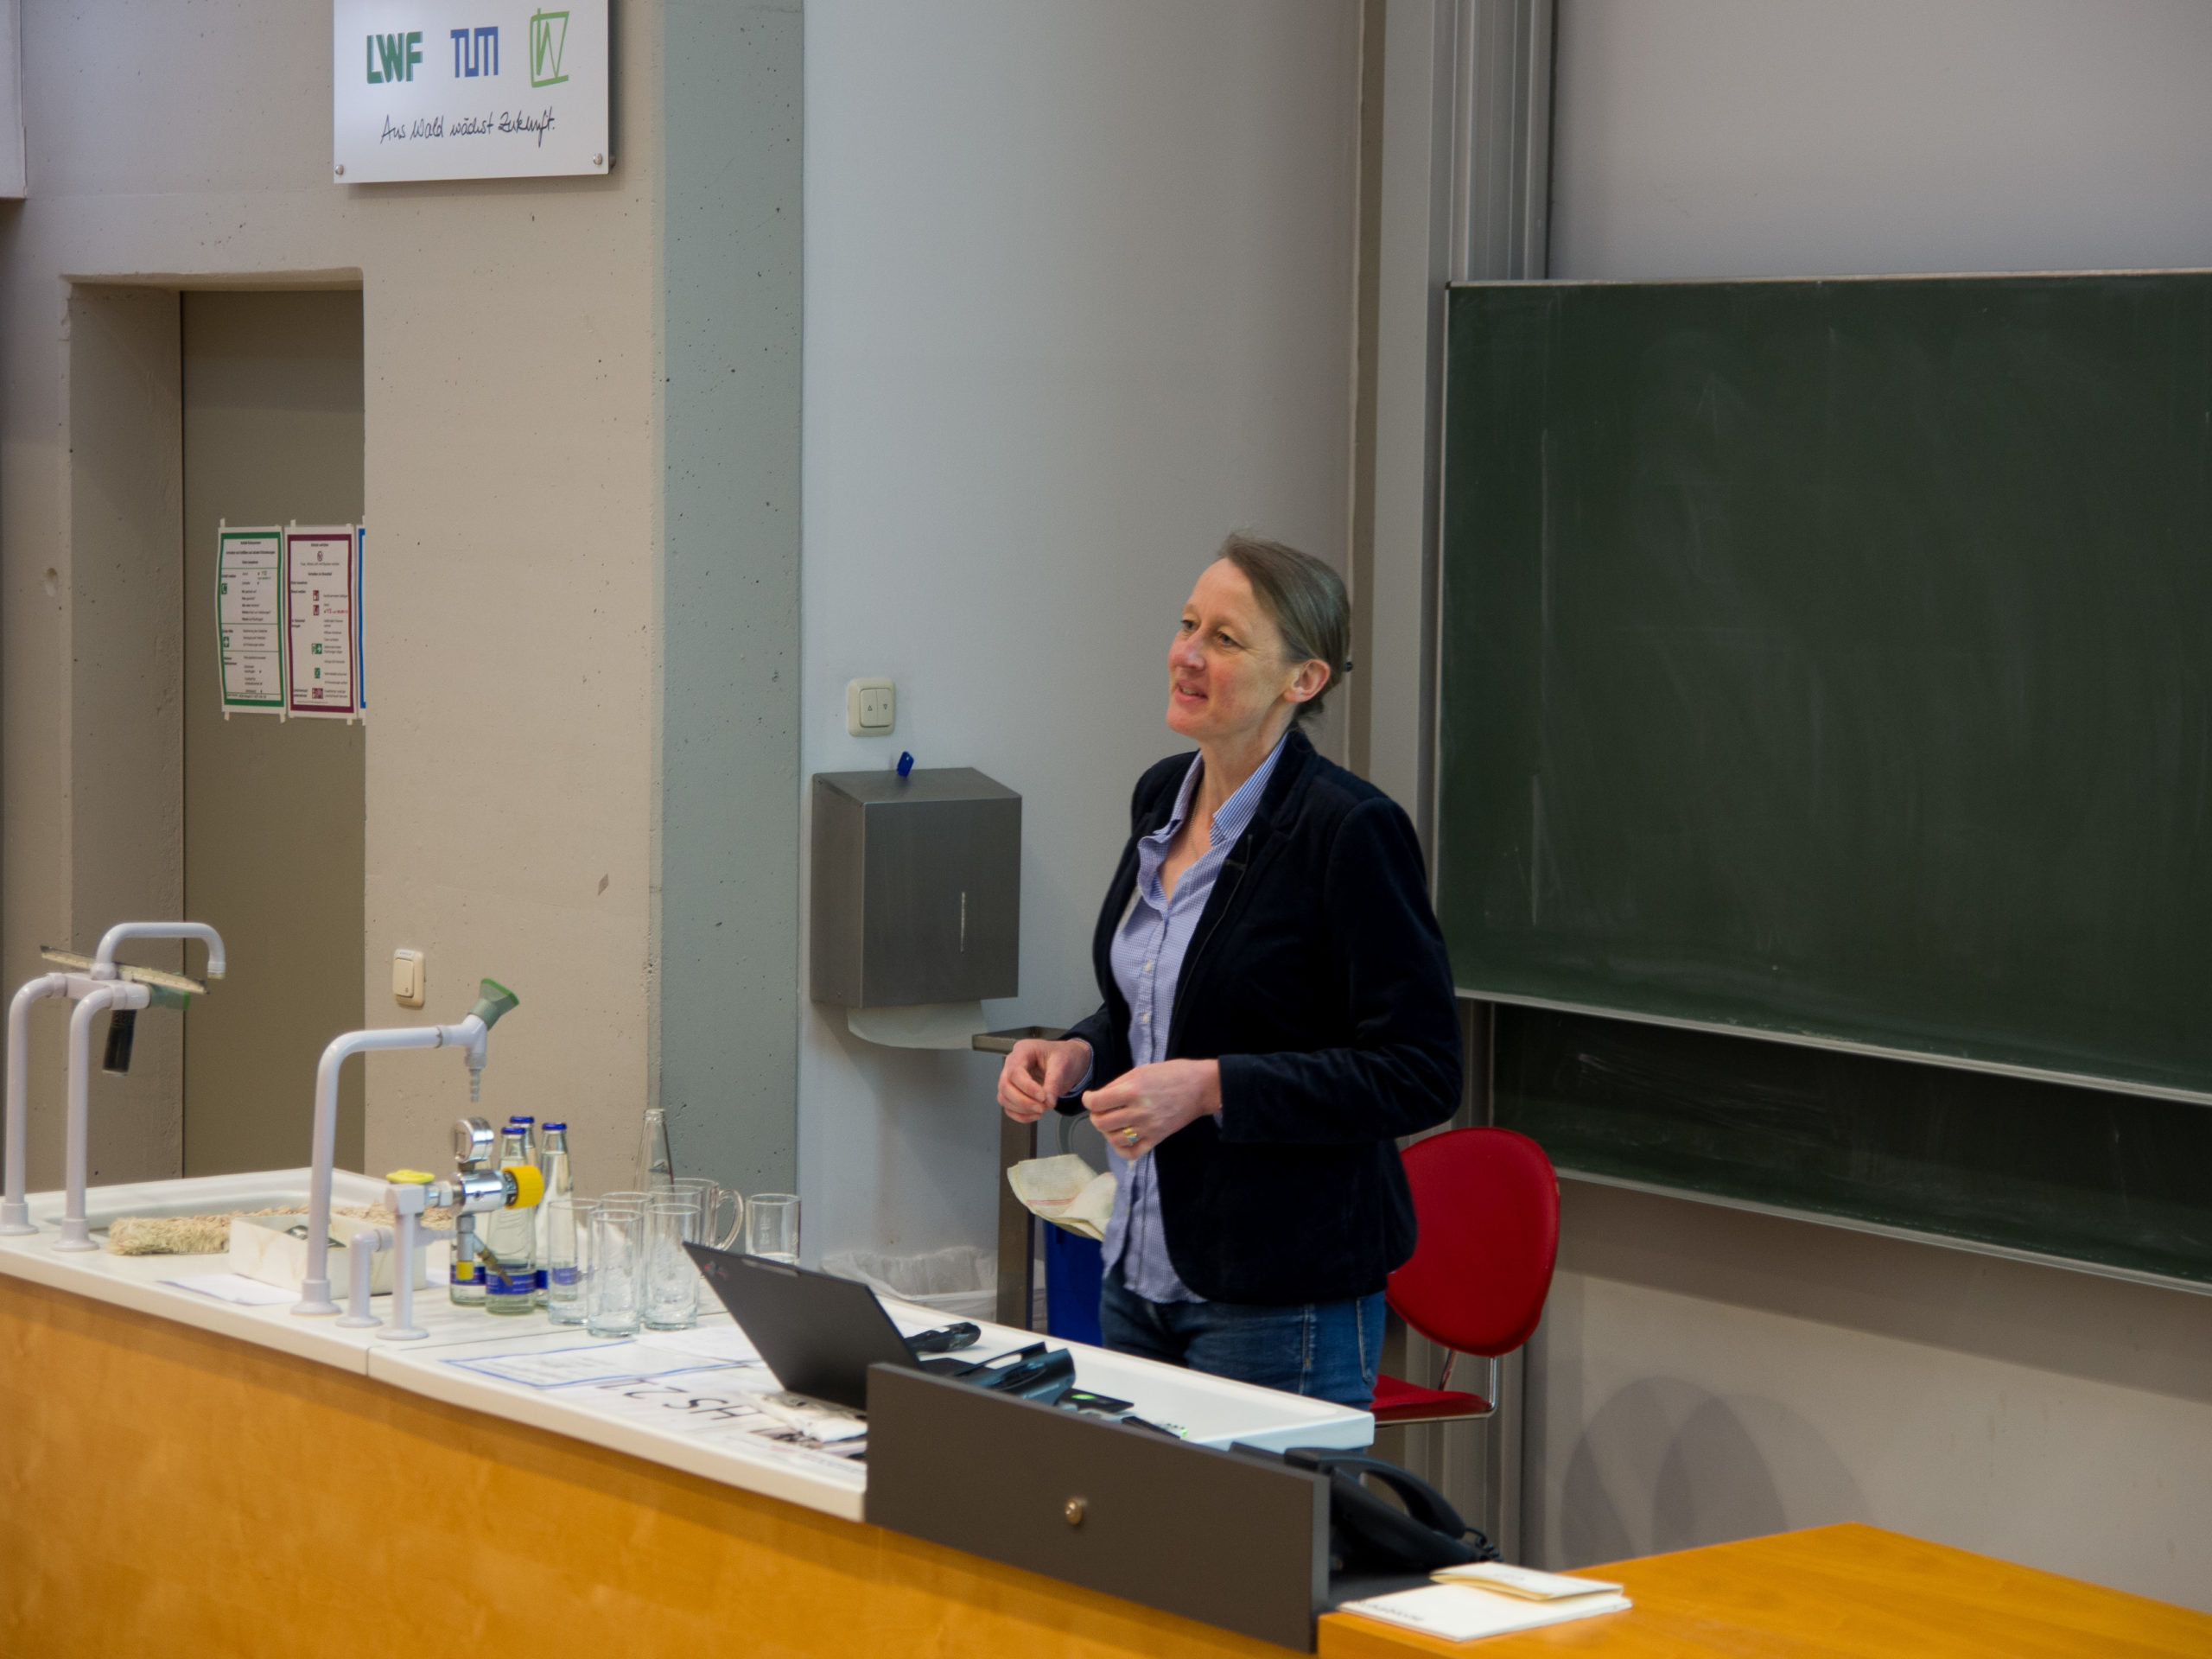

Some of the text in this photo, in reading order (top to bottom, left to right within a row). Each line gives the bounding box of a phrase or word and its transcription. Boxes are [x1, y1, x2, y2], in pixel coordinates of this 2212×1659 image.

[366, 31, 423, 84] LWF
[450, 26, 499, 78] TUM
[380, 114, 406, 144] Aus
[410, 115, 444, 141] Wald
[449, 111, 493, 137] wächst
